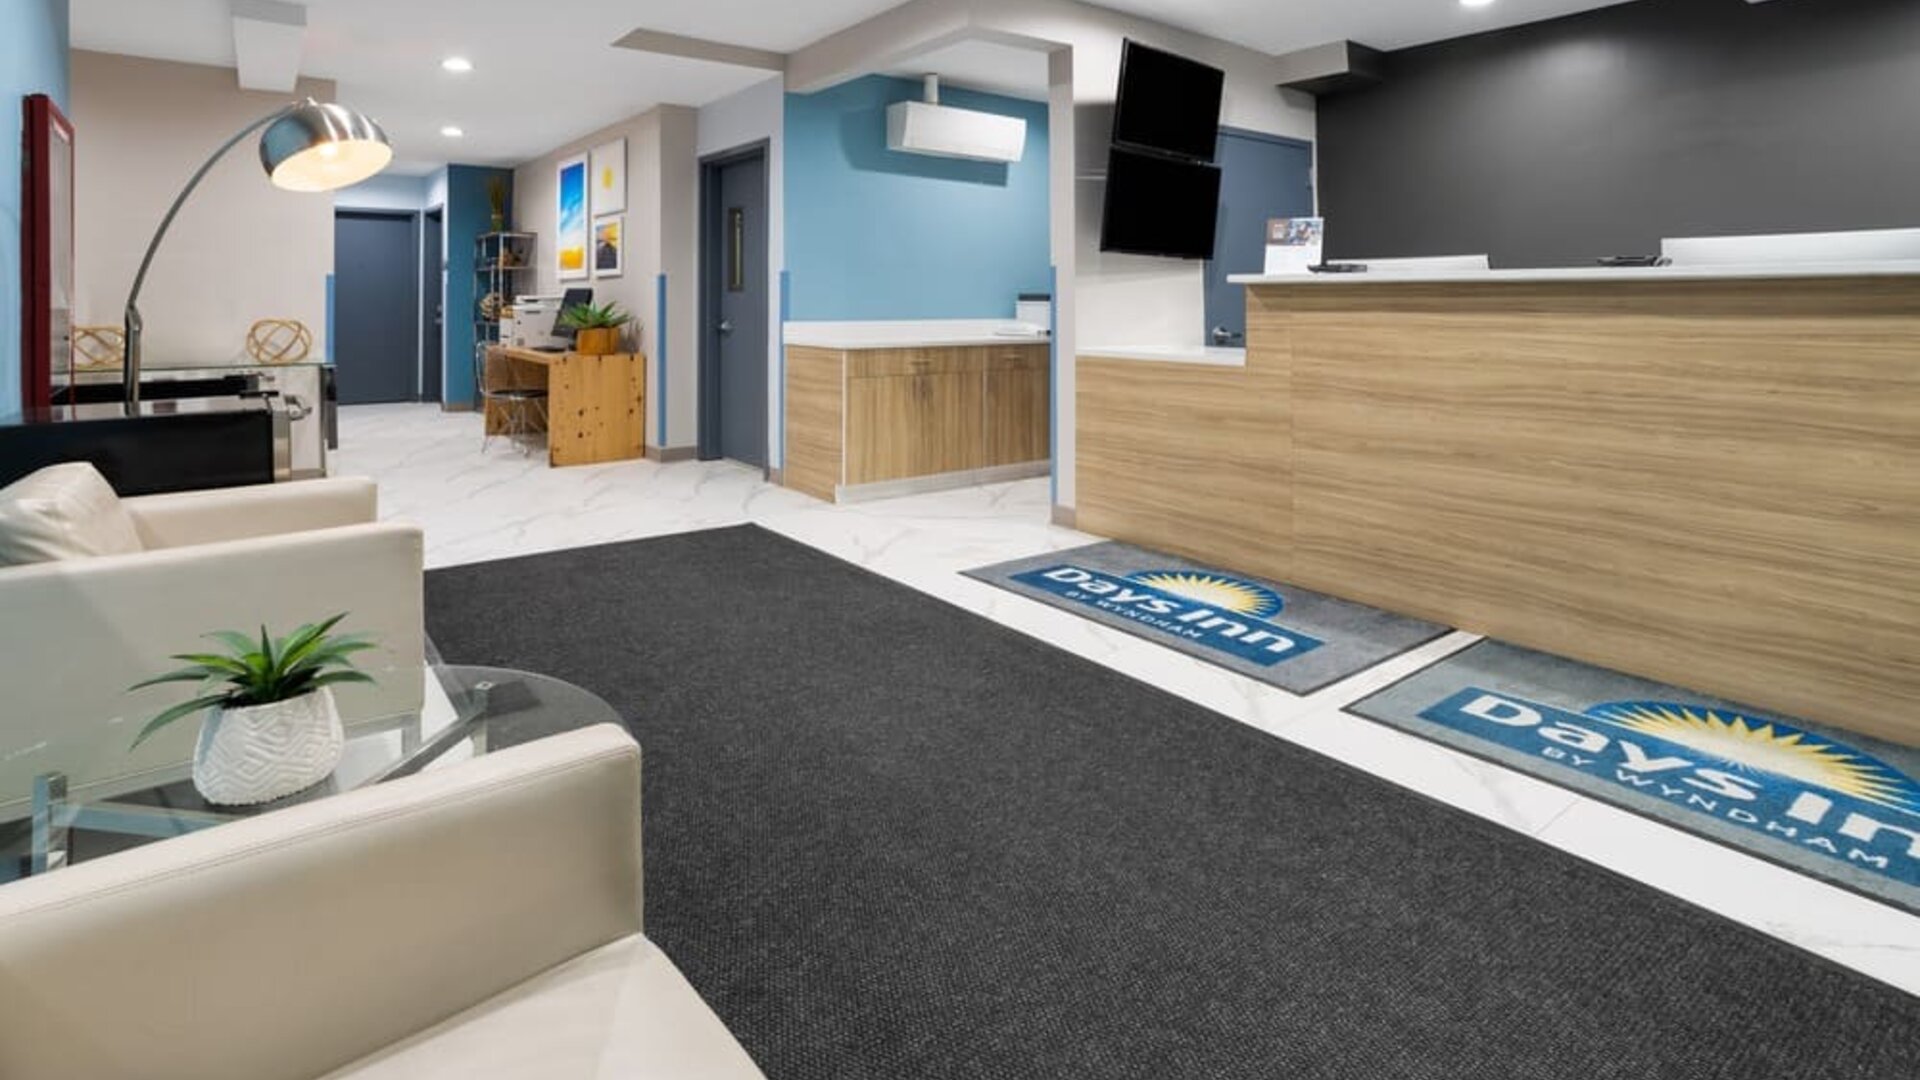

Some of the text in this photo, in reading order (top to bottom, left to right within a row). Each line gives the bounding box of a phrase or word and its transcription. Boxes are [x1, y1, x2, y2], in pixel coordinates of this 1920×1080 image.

[1043, 568, 1295, 652] Days Inn
[1097, 601, 1203, 638] WYNDHAM
[1459, 694, 1763, 801] Days
[1542, 746, 1889, 868] BY WYNDHAM
